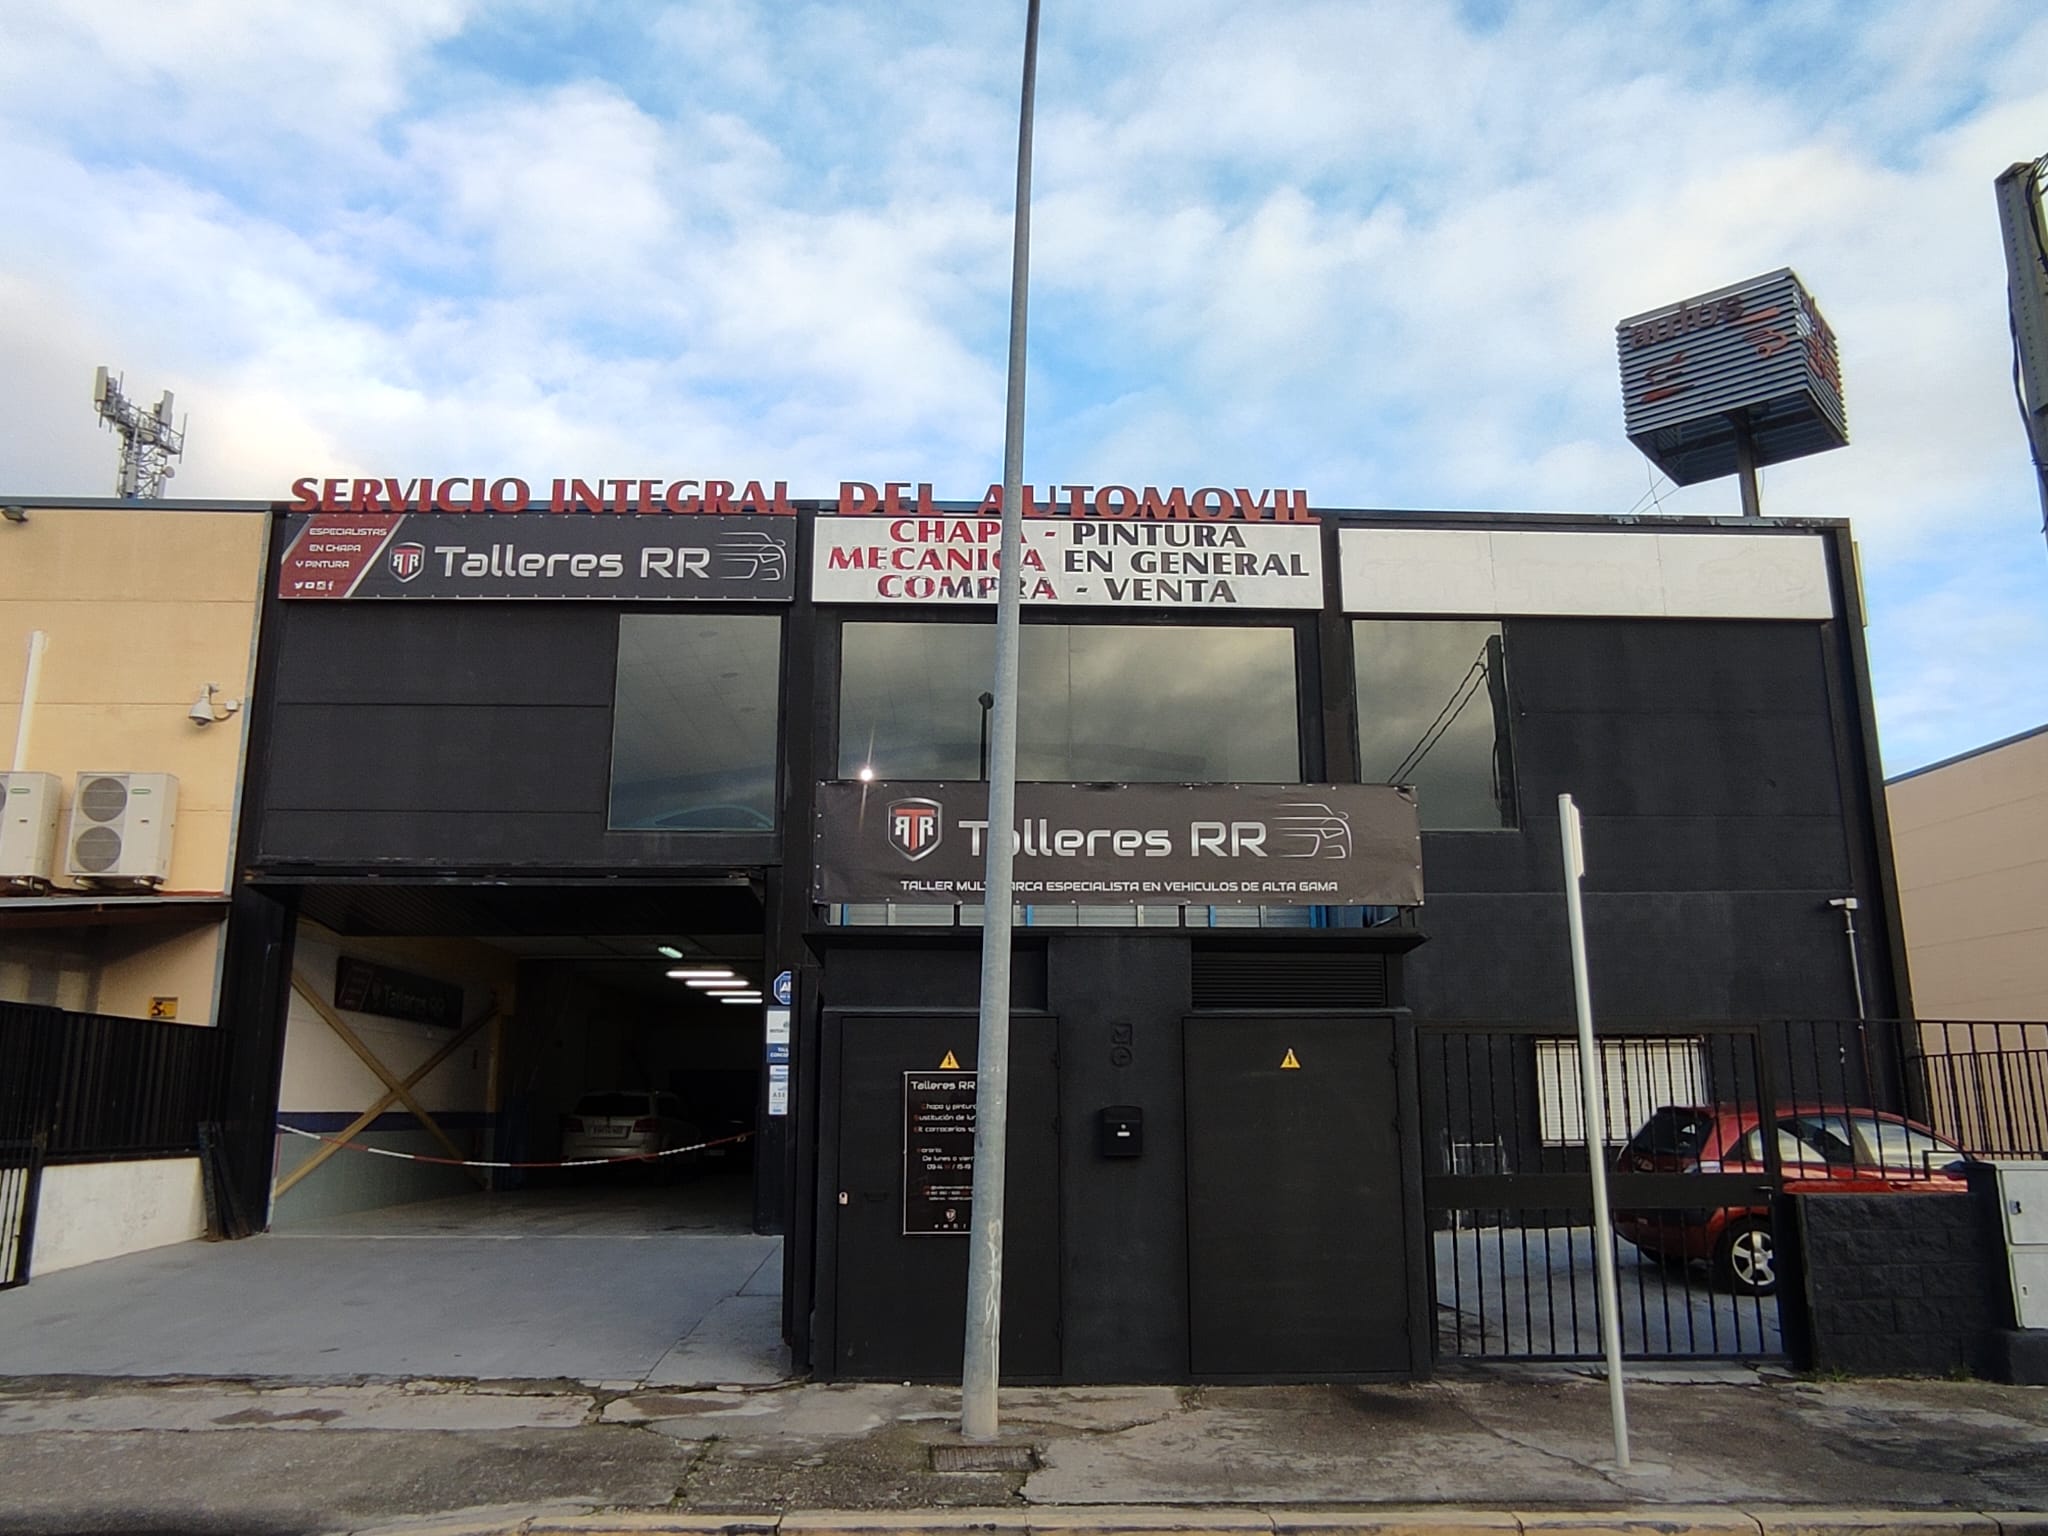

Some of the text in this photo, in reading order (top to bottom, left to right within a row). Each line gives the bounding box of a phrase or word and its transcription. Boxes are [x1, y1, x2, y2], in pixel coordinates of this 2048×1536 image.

[288, 478, 1321, 524] SERVICIO INTEGRAL DEL AUTOMOVIL
[309, 527, 387, 536] ESPECIALISTAS
[889, 520, 1027, 544] CHAP
[1072, 523, 1246, 548] PINTURA
[309, 543, 361, 552] EN CHAPA
[296, 560, 349, 568] Y PINTURA
[434, 544, 711, 579] Talleres RR
[1065, 549, 1112, 573] EN
[1130, 552, 1310, 577] GENERAL
[1104, 578, 1237, 603] VENTA
[958, 818, 1268, 857] Tlleres RR
[900, 880, 953, 892] TALLER
[1046, 880, 1139, 892] ESPECIALISTA
[1142, 881, 1161, 892] EN
[1164, 881, 1239, 892] VEHICULOS
[1241, 882, 1260, 892] DE
[1262, 882, 1296, 892] ALTA
[1299, 882, 1338, 893] GAMA
[910, 1080, 976, 1090] Talleres RR
